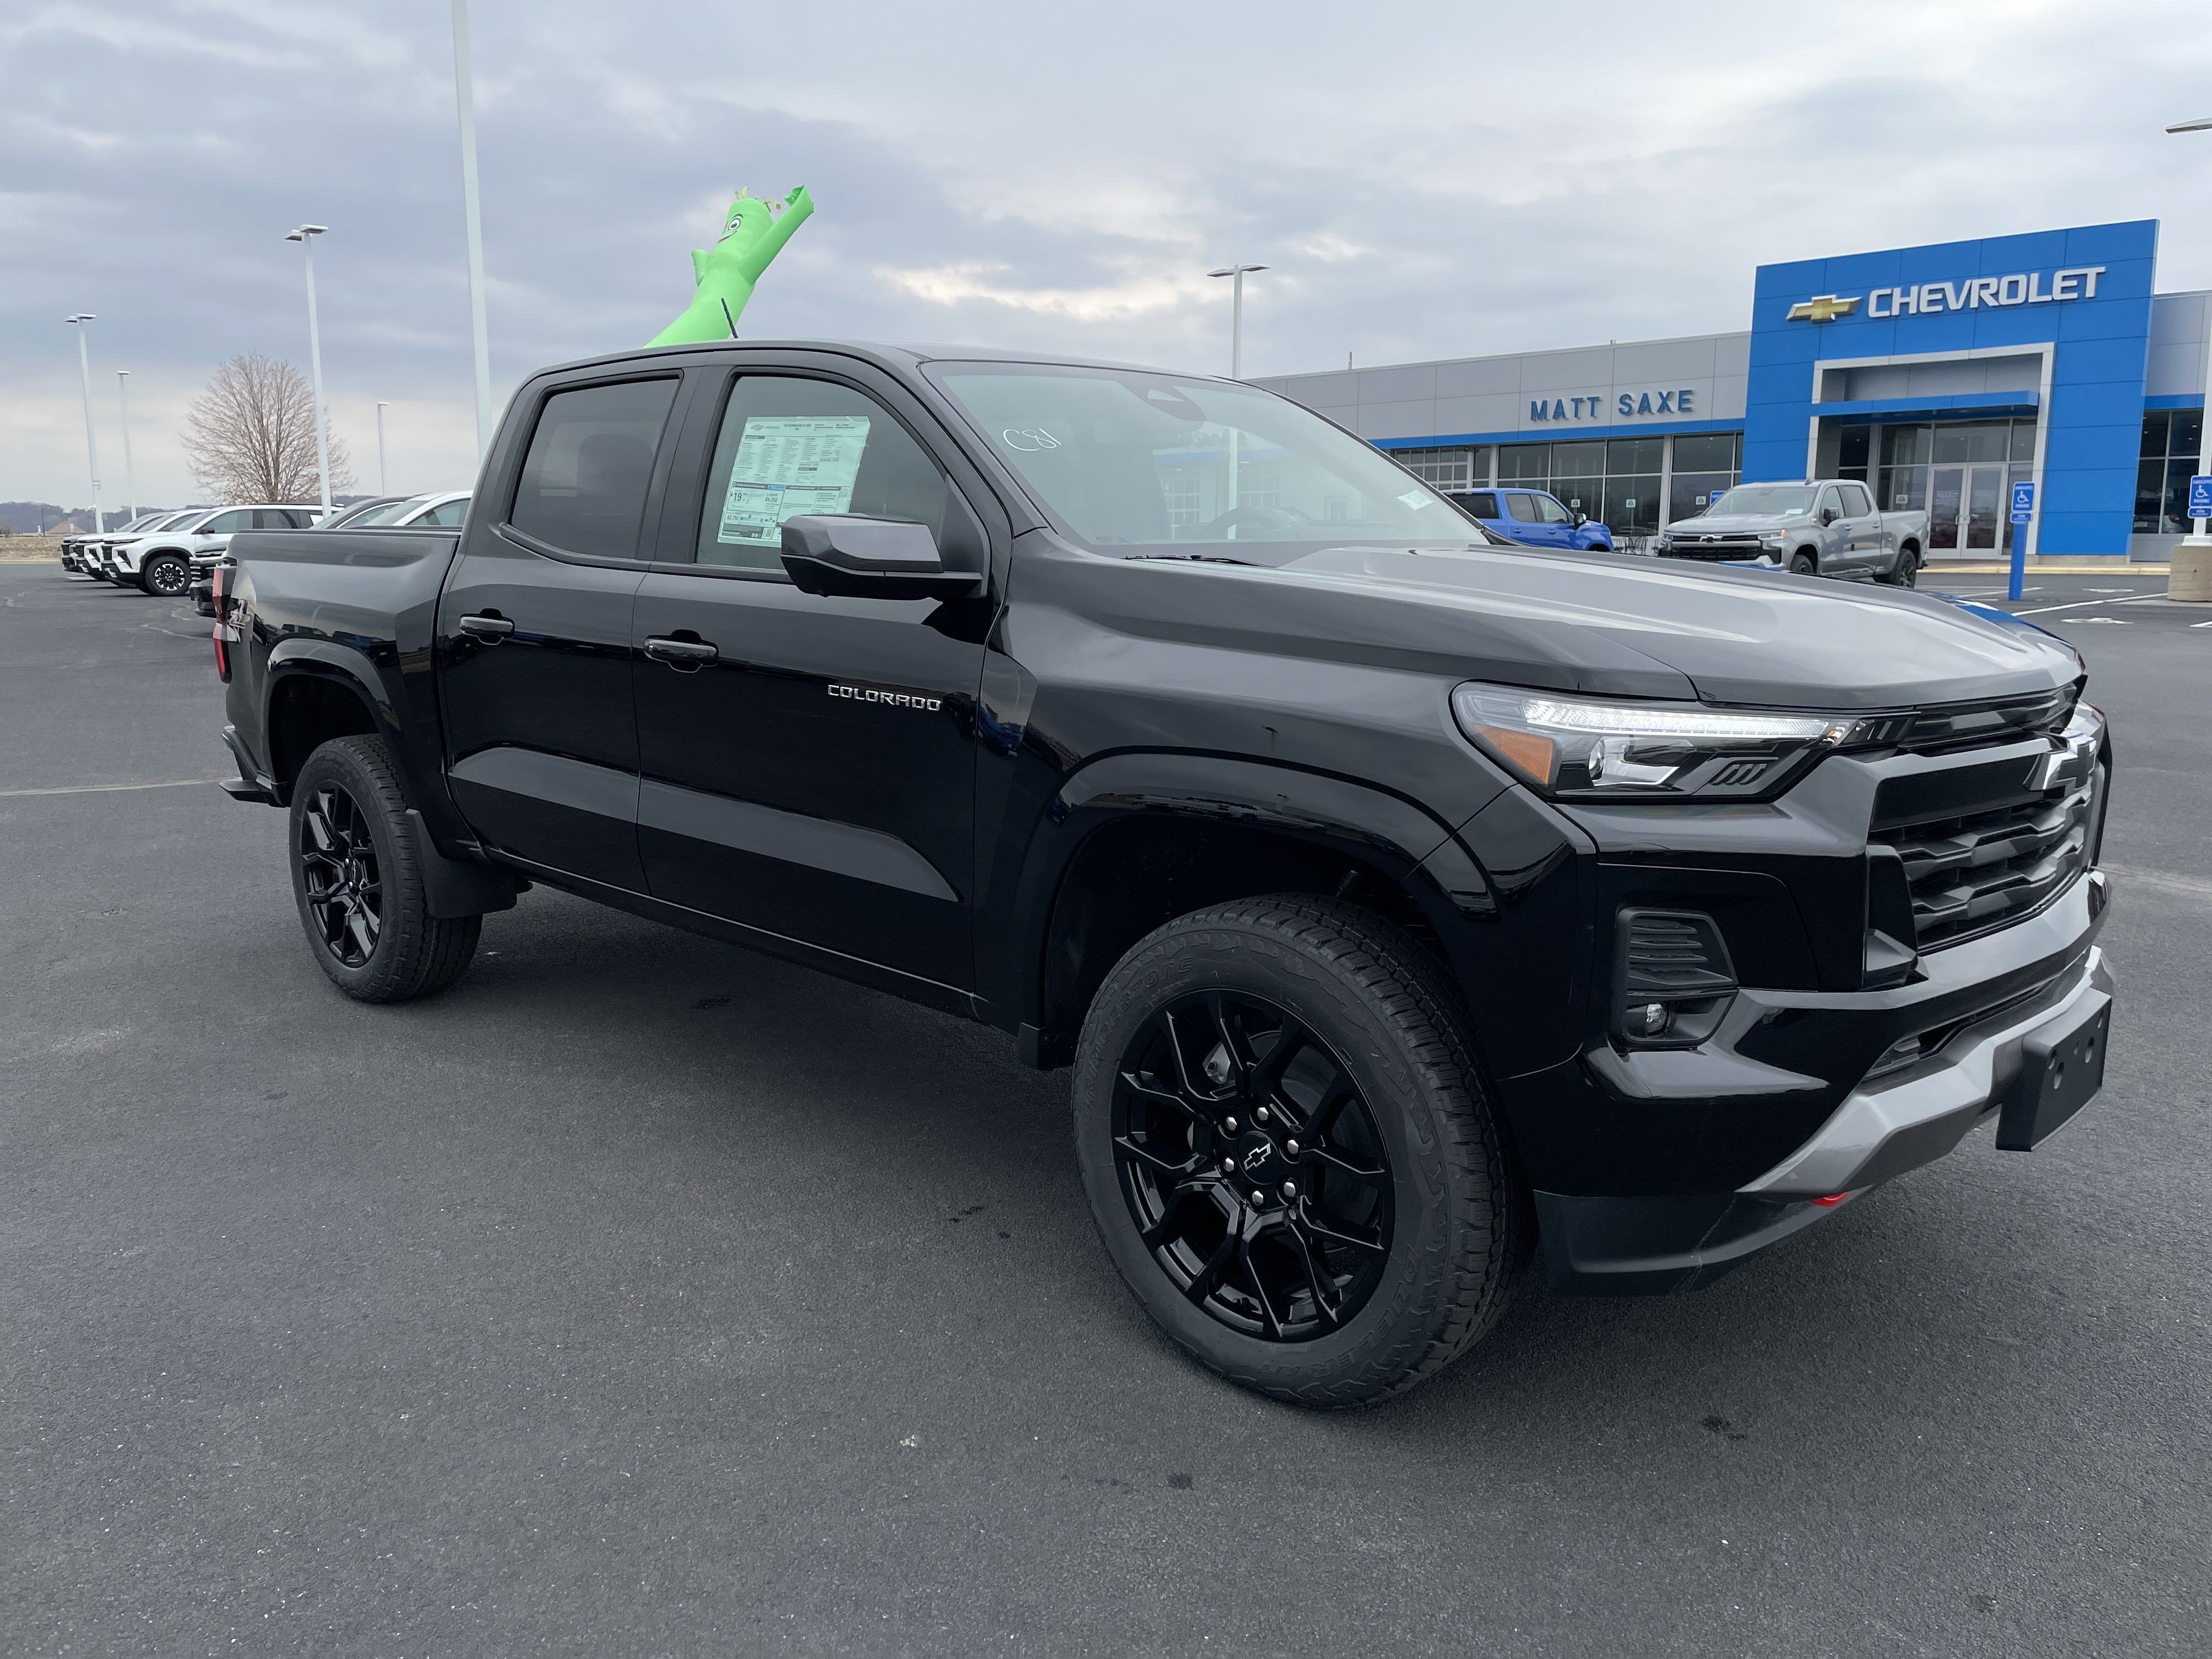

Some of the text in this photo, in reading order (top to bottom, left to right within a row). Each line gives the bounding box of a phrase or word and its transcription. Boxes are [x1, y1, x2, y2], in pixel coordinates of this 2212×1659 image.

[1868, 266, 2107, 319] CHEVROLET
[1530, 389, 1695, 421] MATT SAXE
[733, 492, 742, 501] 19
[827, 684, 941, 712] COLORADO
